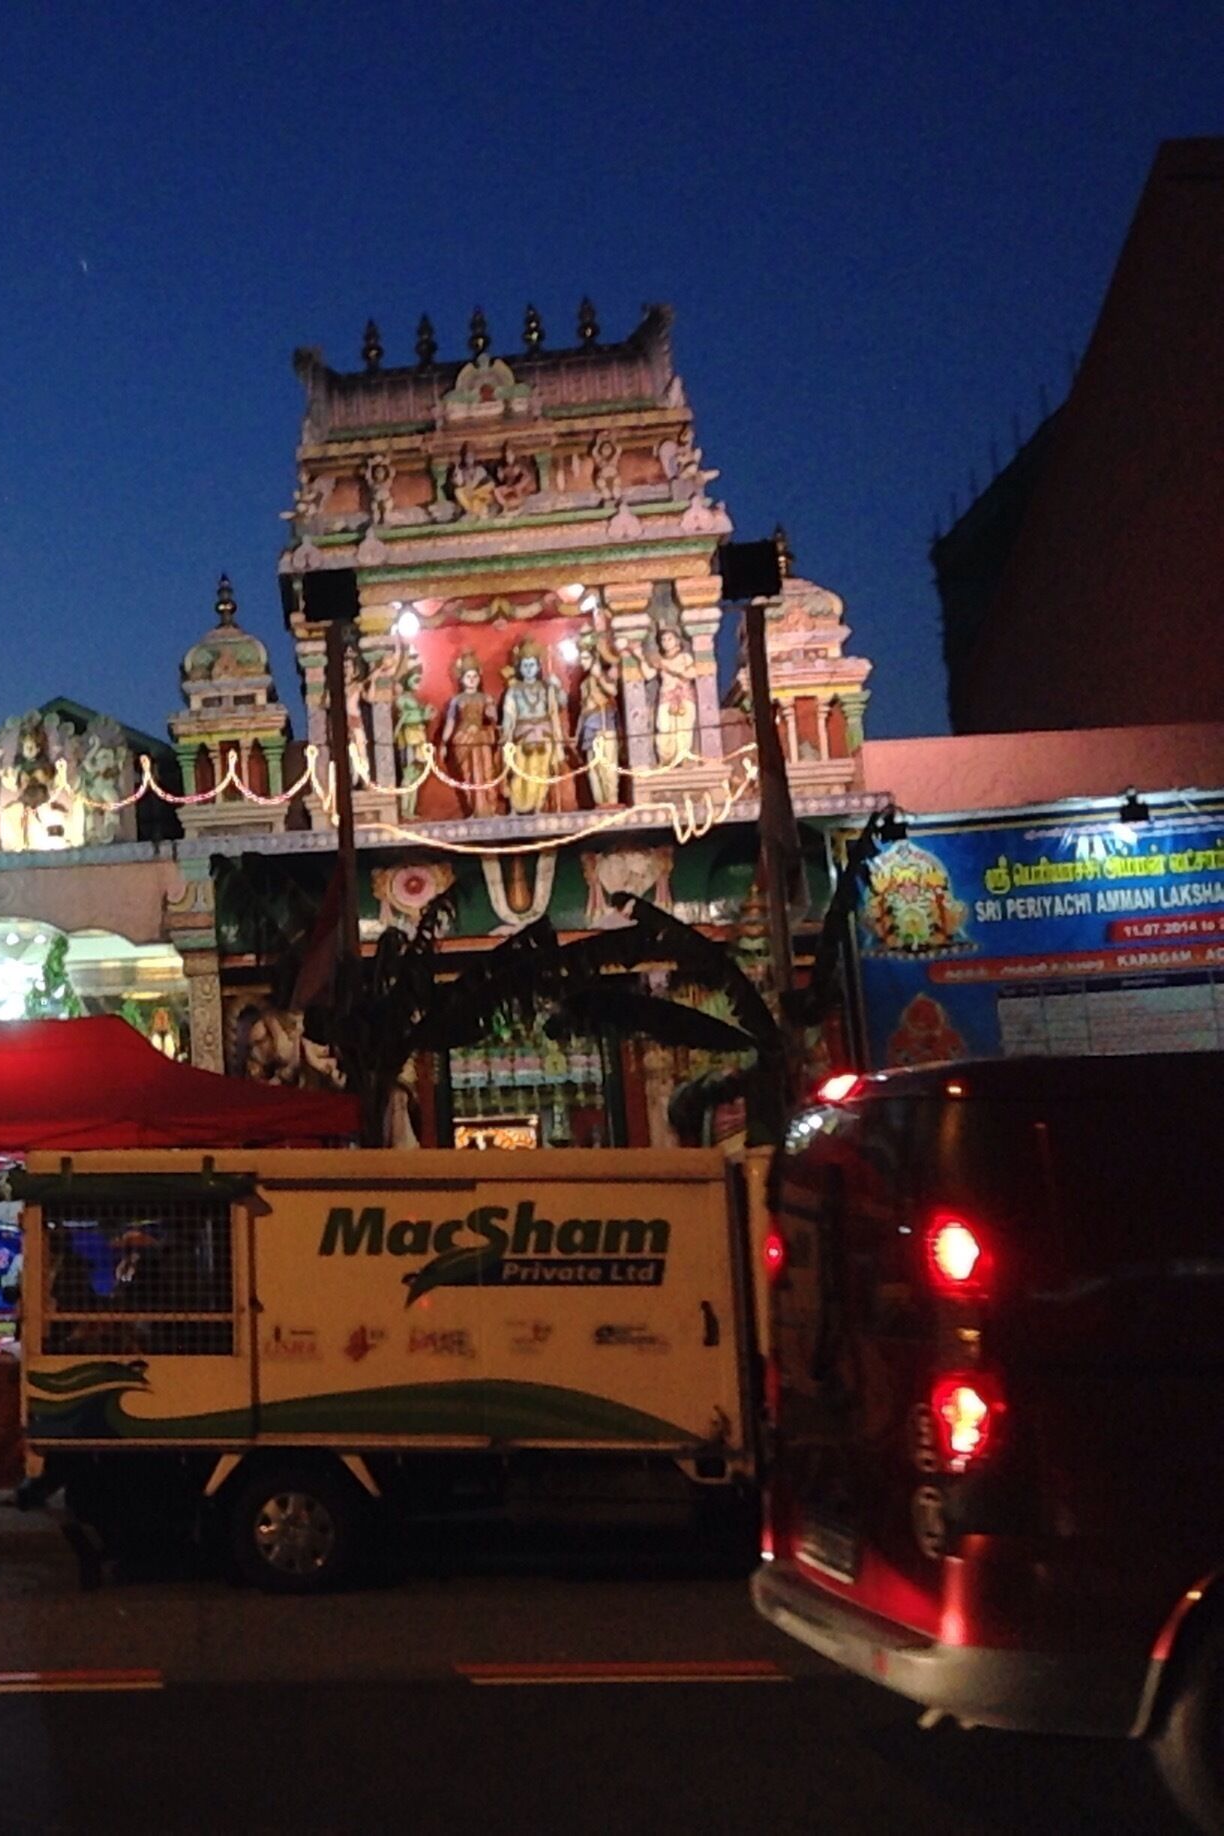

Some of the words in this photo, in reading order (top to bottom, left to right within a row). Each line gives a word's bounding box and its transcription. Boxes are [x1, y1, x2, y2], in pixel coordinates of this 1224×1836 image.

[975, 899, 1002, 922] SRI
[1006, 892, 1092, 919] PERIYACHI
[1096, 887, 1156, 913] AMMAN
[319, 1201, 671, 1256] MacSham
[502, 1262, 602, 1281] Private
[609, 1262, 655, 1281] Ltd
